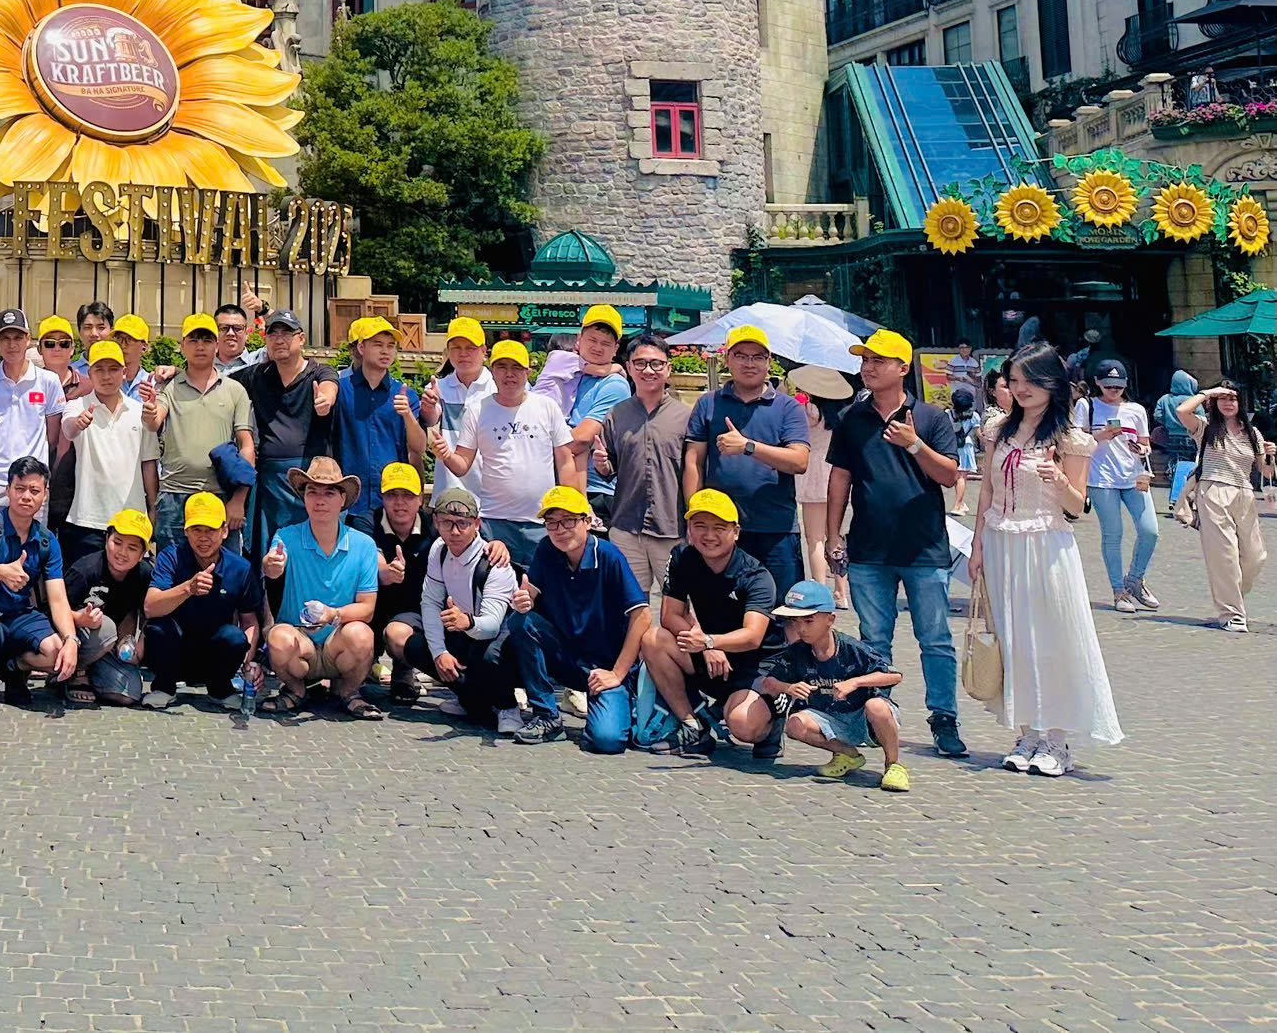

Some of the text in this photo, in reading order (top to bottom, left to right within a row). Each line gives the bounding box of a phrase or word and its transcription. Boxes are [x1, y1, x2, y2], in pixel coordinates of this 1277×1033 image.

[55, 37, 110, 63] SUN
[50, 61, 165, 91] KRAFTBEER
[106, 85, 146, 95] SIGNATURE
[12, 180, 279, 267] FESTIVAL
[810, 678, 845, 688] FASHIO
